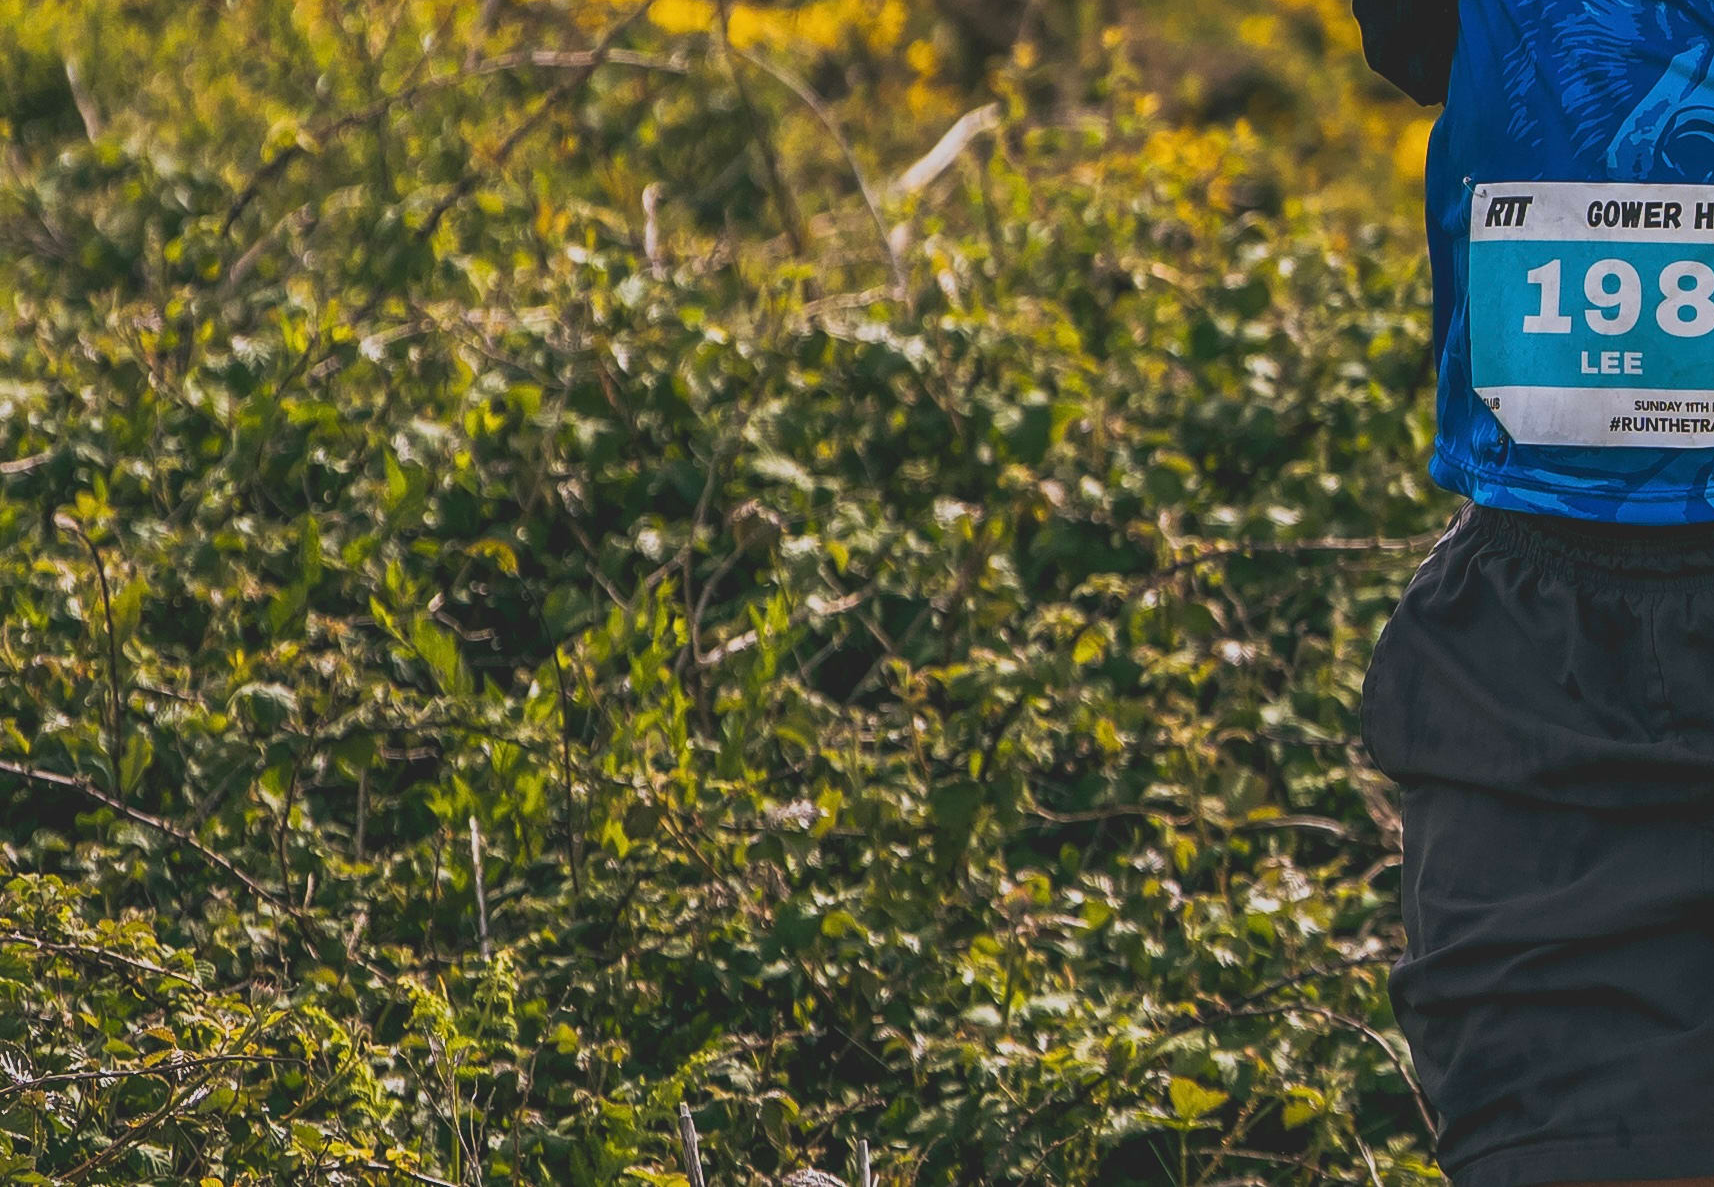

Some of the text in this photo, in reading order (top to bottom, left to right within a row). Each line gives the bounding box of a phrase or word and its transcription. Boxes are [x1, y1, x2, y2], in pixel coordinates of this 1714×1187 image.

[1485, 196, 1534, 227] RTT
[1587, 200, 1683, 228] GOWER
[1581, 351, 1643, 374] LEE
[1634, 400, 1682, 412] SUNDAY
[1686, 402, 1709, 412] 11TH
